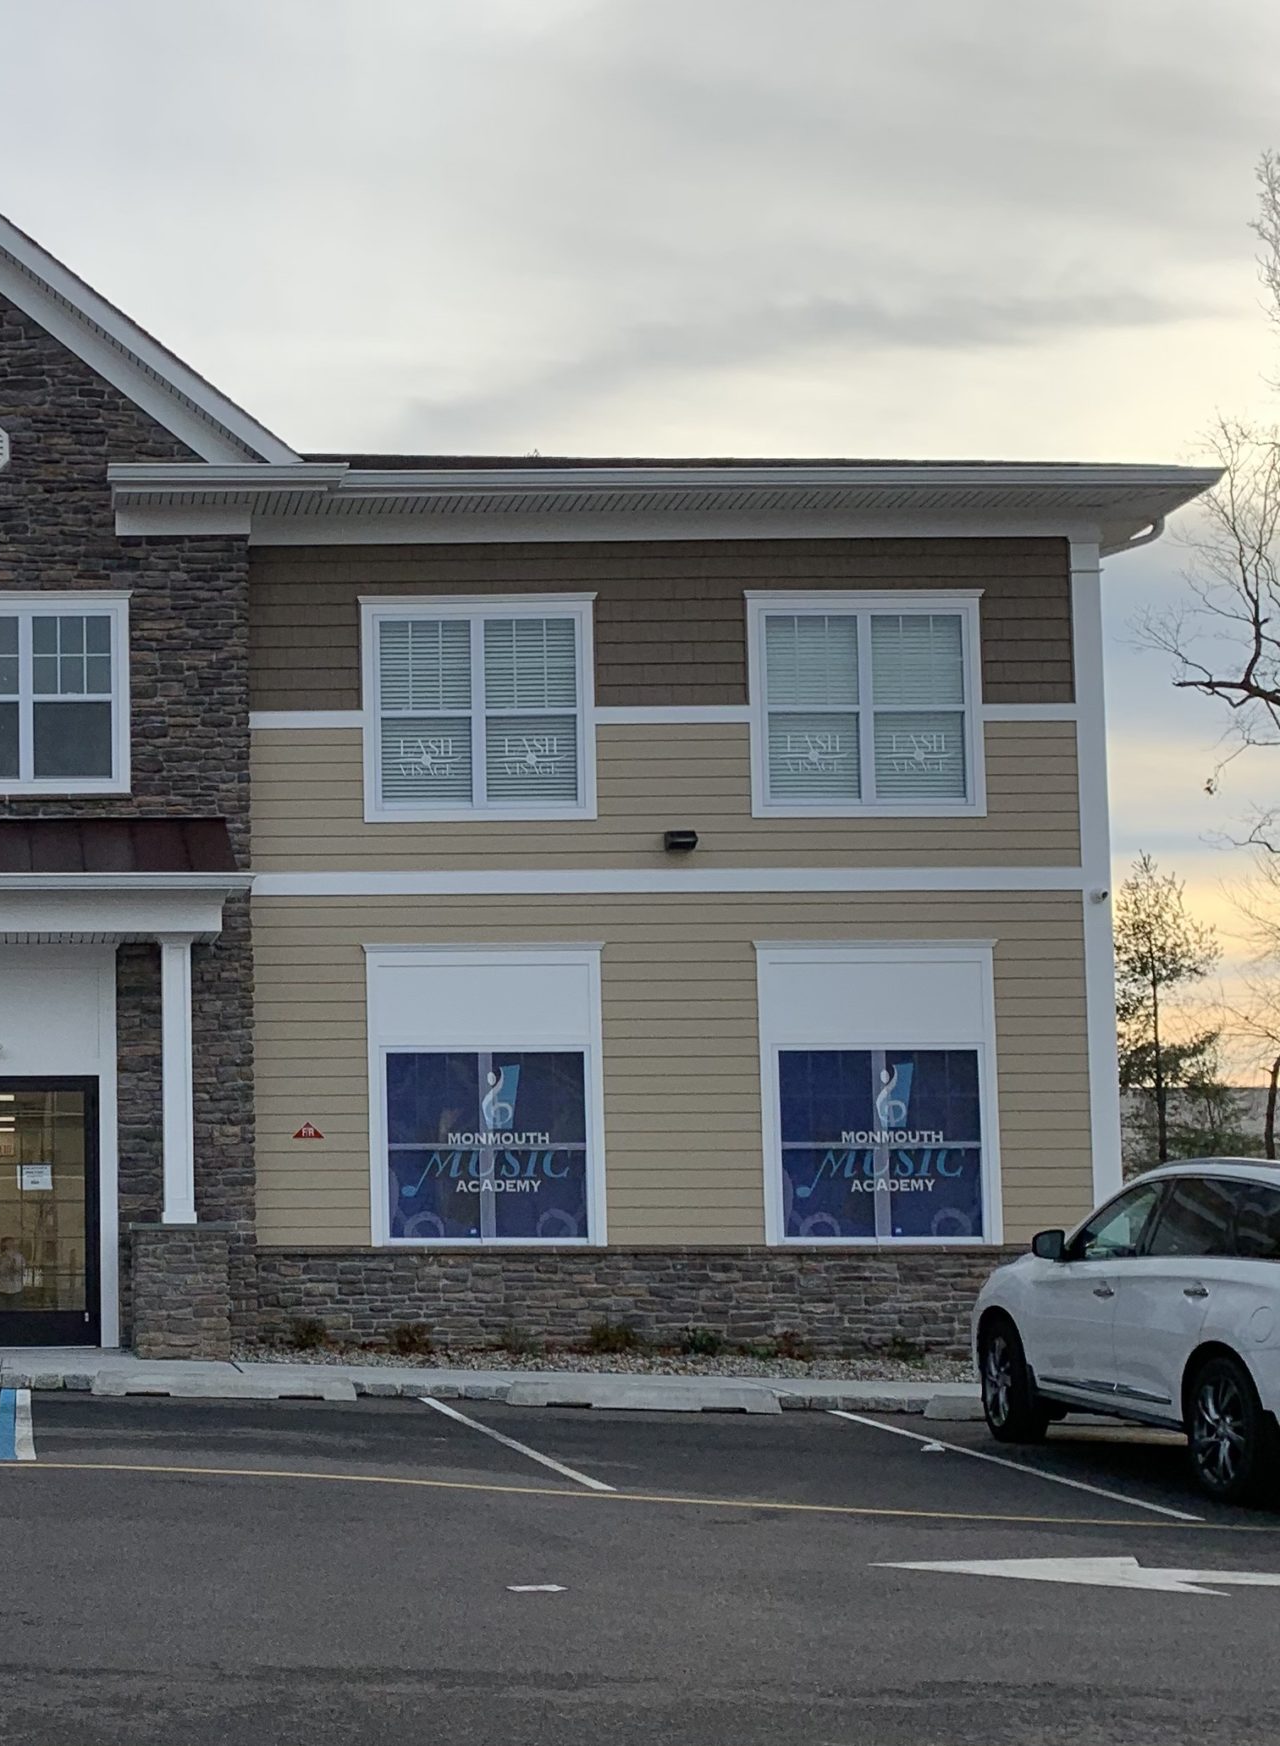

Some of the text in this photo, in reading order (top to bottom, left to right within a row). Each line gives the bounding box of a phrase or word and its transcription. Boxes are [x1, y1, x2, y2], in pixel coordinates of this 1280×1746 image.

[400, 738, 453, 755] LASH
[504, 737, 558, 754] LASH
[786, 735, 840, 751] LASH
[891, 734, 945, 752] LASH
[448, 1132, 550, 1145] MONMOUTH
[841, 1131, 944, 1144] MONMOUTH
[402, 1146, 570, 1196] MUSIC
[796, 1146, 966, 1198] MUSIC
[456, 1180, 542, 1193] ACADEMY
[851, 1179, 936, 1192] ACADEMY
